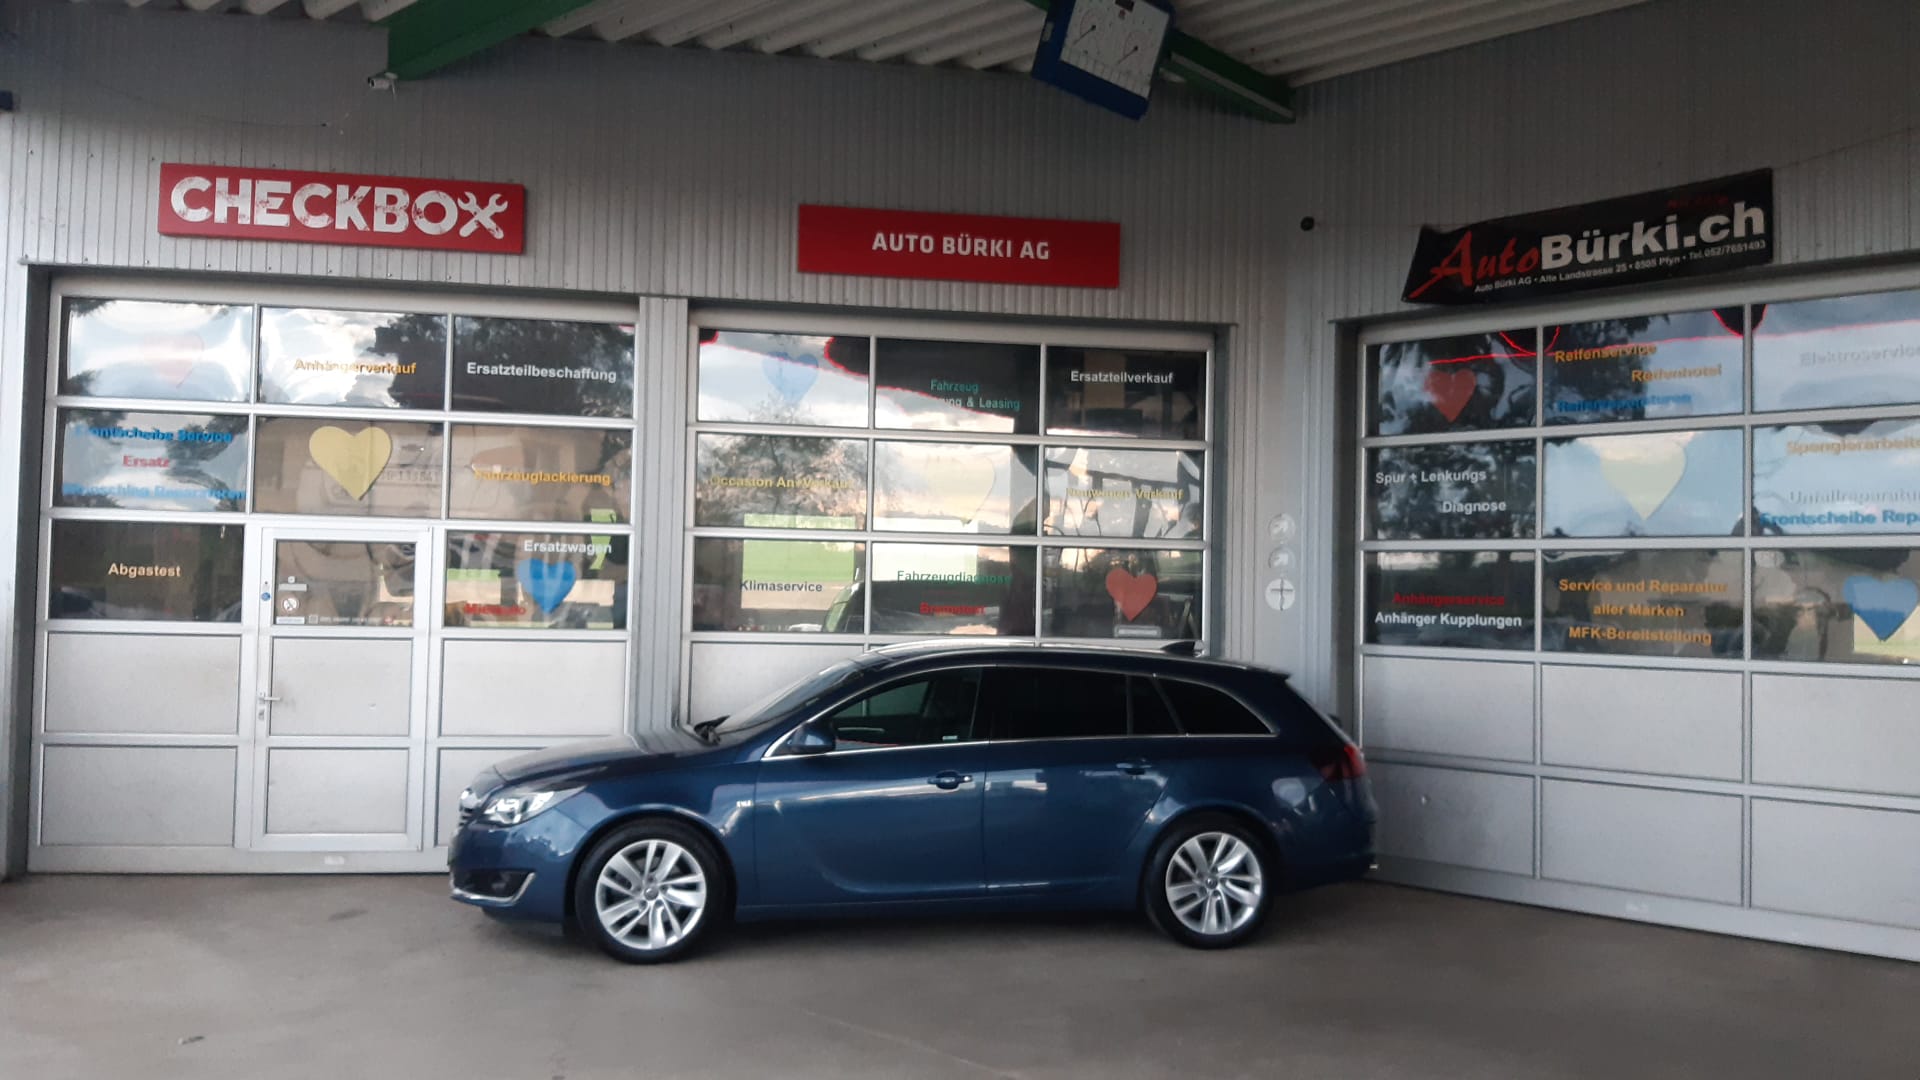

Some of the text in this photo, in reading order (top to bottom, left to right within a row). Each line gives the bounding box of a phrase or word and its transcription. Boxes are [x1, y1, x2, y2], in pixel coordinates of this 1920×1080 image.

[872, 232, 1049, 260] AUTO BÜRKI AG
[1474, 283, 1493, 293] Auto
[1494, 278, 1517, 290] Bürki
[1518, 276, 1532, 286] AG
[1559, 265, 1613, 281] Landstrasse
[1554, 344, 1657, 363] Reifenservice
[295, 358, 417, 375] Anhängerverkauf
[466, 361, 617, 384] Ersatzteilbeschaffung
[1631, 363, 1722, 382] Reifenhotel
[1070, 369, 1175, 384] Ersatzteilverkauf
[930, 378, 980, 396] Fahrzeug
[966, 396, 974, 408] &
[979, 397, 1021, 412] Leasing
[177, 428, 233, 444] Service
[122, 454, 170, 468] Ersatz
[473, 470, 612, 486] Fahrzeuglackierung
[710, 475, 773, 488] Occasion
[1375, 469, 1487, 486] Spur + Lenkungs
[1443, 500, 1507, 515] Diagnose
[1759, 511, 1877, 526] Frontscheibe
[523, 539, 612, 556] Ersatzwagen
[107, 562, 182, 578] Abgastest
[897, 570, 1013, 586] Fahrzeugdiagnose
[739, 579, 823, 593] Klimaservice
[1558, 578, 1729, 595] Service und Reparatur
[1592, 603, 1685, 617] aller Marken
[1374, 611, 1523, 629] Anhänger Kupplungen
[1568, 626, 1712, 646] MFK-Bereitstellung
